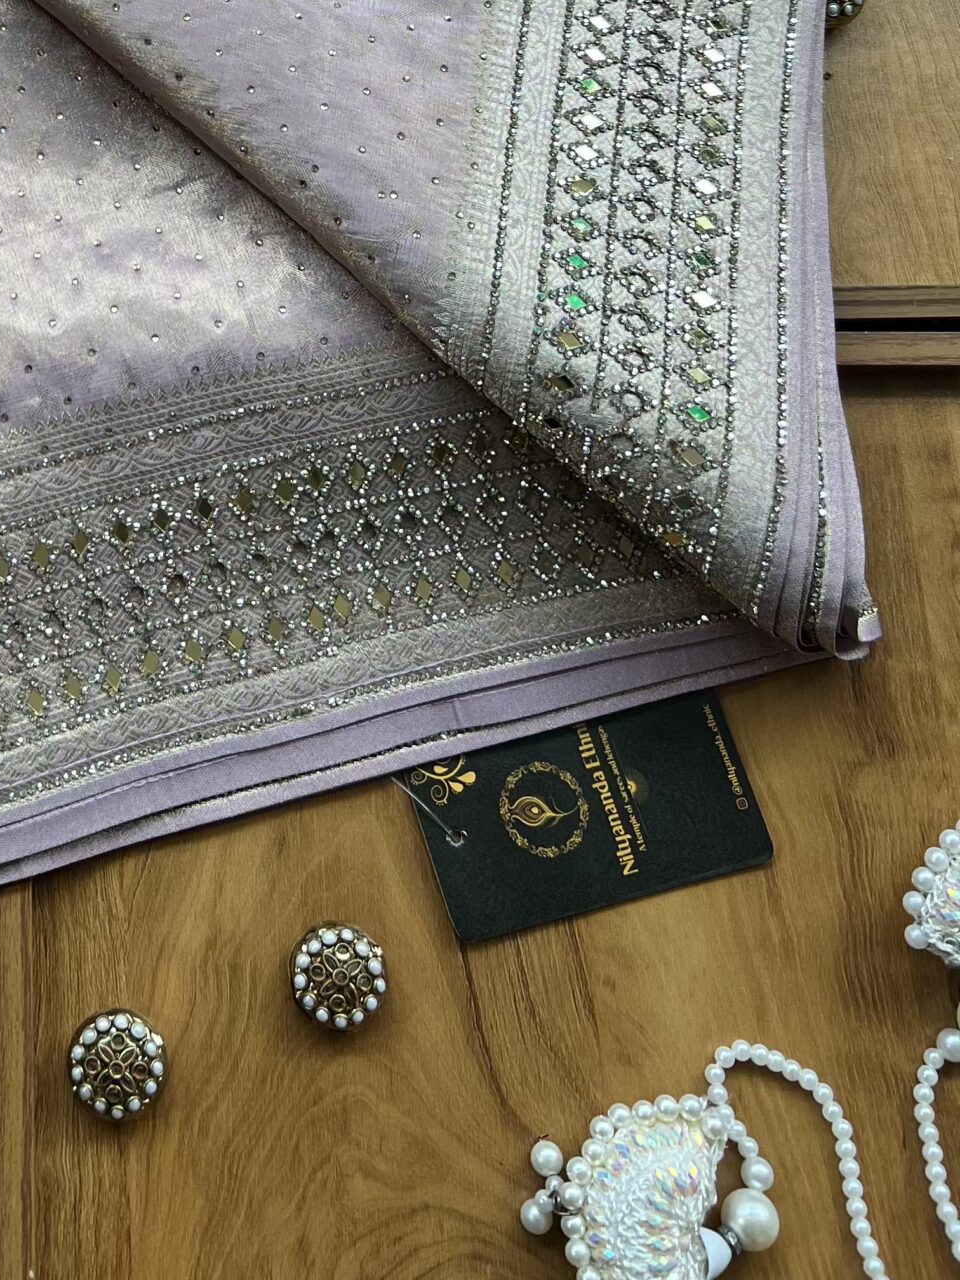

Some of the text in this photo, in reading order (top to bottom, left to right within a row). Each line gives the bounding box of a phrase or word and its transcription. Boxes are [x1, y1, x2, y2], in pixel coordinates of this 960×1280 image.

[573, 722, 639, 876] Nityananda Ethni
[608, 760, 620, 775] and
